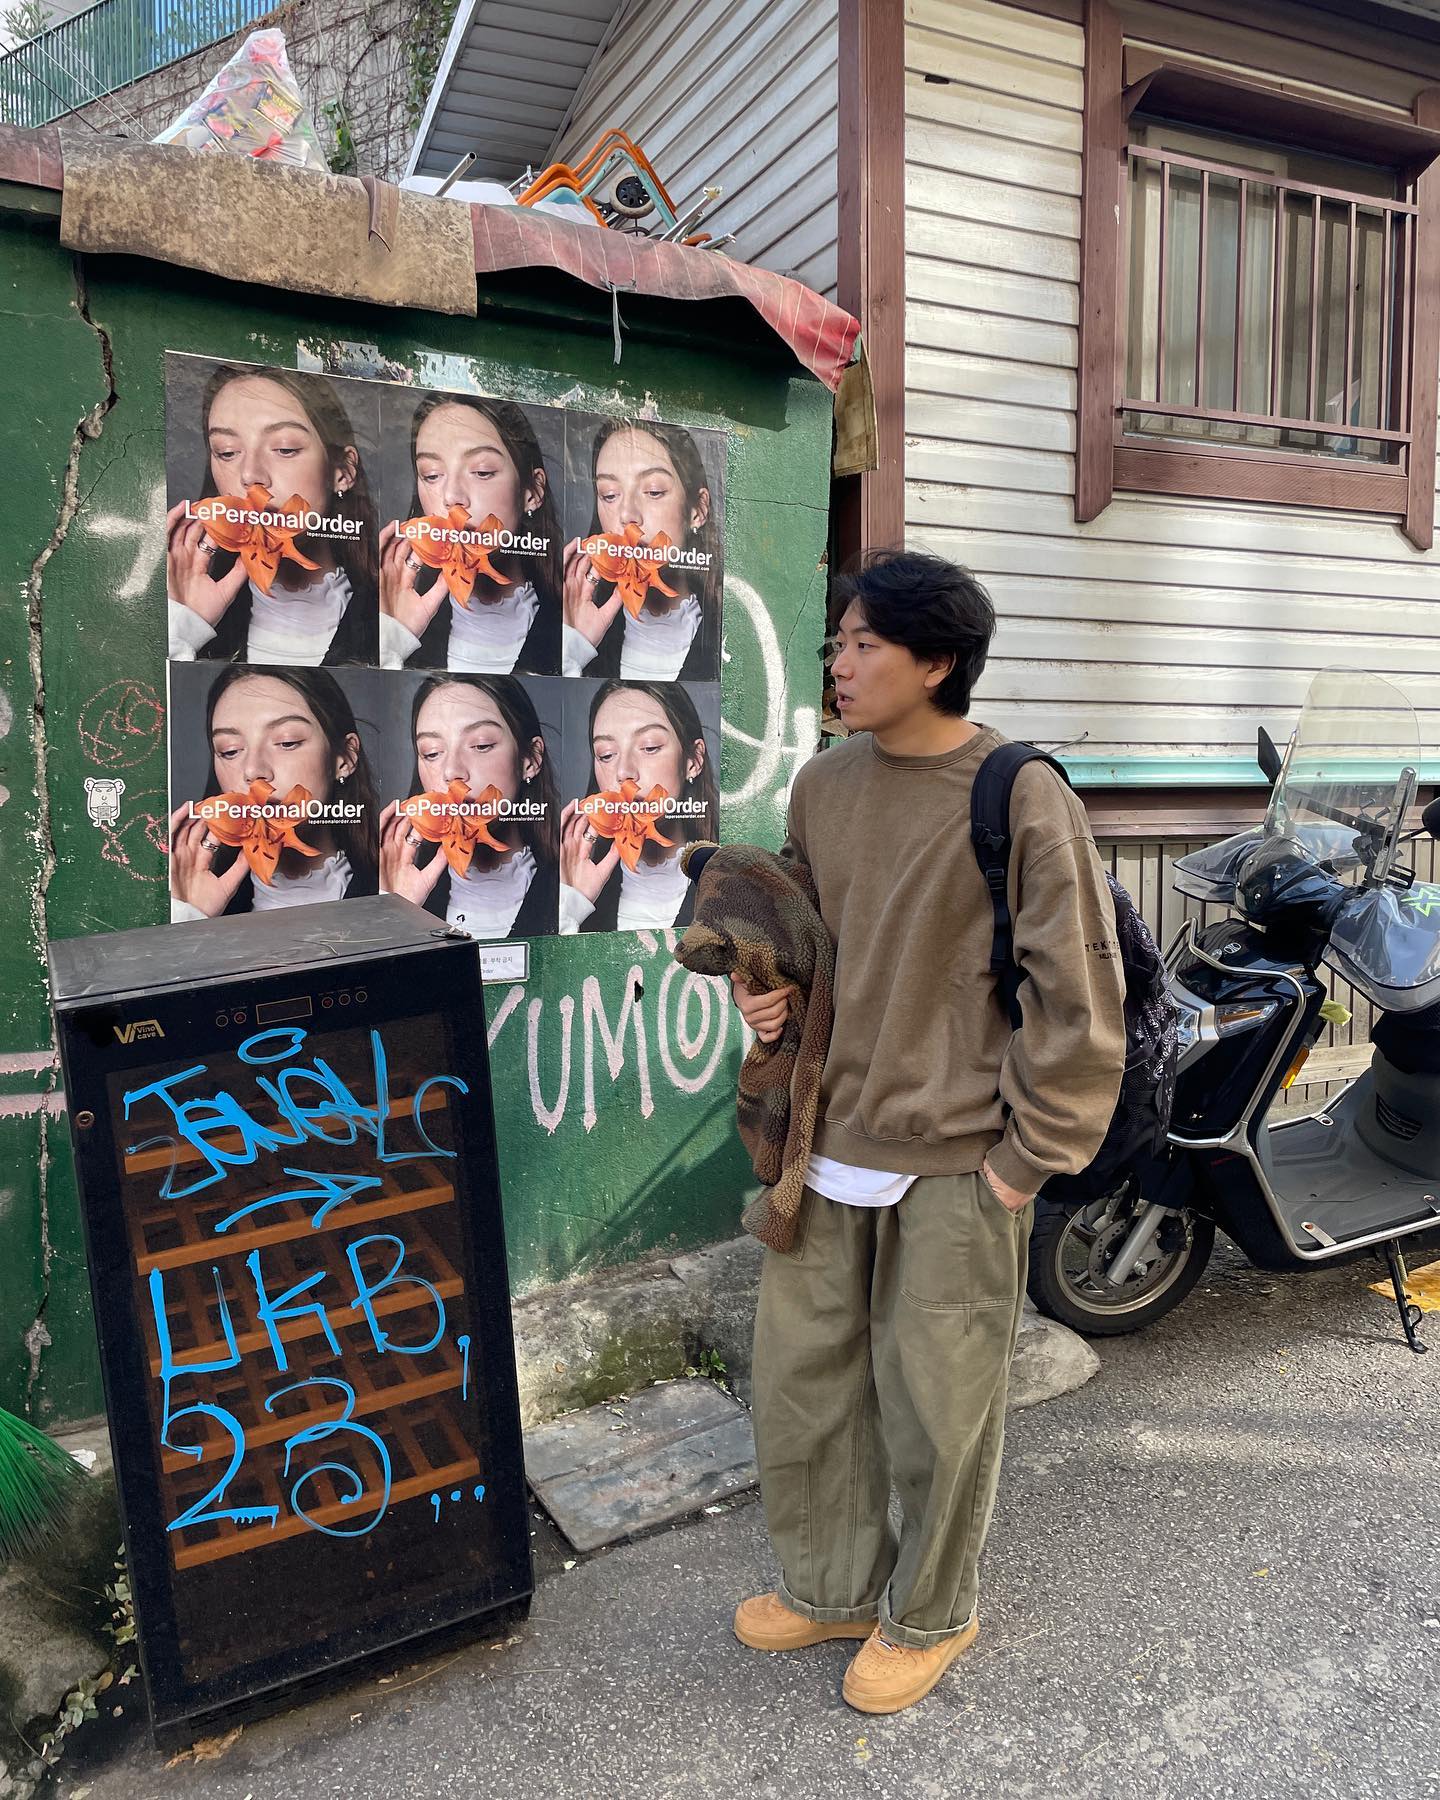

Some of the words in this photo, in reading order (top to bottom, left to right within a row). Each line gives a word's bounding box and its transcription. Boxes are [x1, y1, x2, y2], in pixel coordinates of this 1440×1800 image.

[185, 499, 364, 535] LePersonalOrder
[306, 531, 361, 541] lepersonalorder.com
[394, 519, 550, 550] LePersonalOrder
[576, 536, 713, 565] LePersonalOrder
[188, 800, 365, 819] LePersonalOrder
[395, 799, 548, 817] LePersonalOrder
[574, 797, 709, 815] LePersonalOrder
[308, 818, 362, 826] lepersonalorder.com
